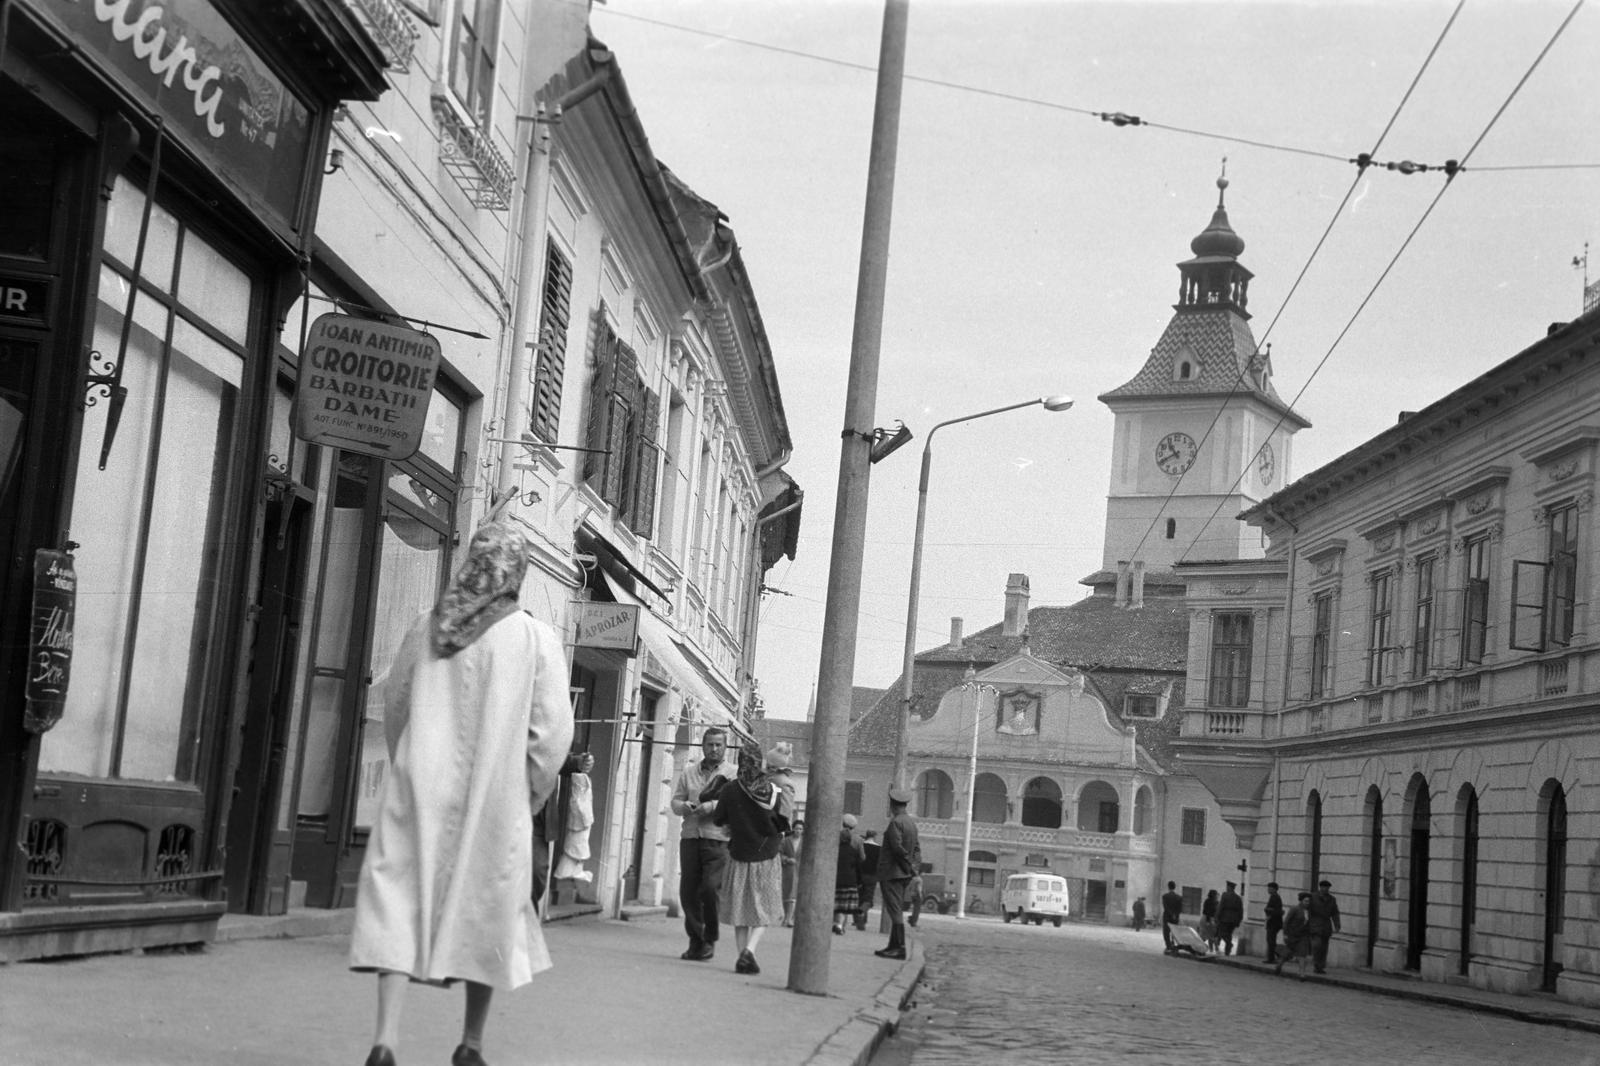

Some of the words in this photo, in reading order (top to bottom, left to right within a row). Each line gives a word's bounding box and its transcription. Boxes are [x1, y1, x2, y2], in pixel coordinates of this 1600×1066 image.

[0, 286, 28, 311] R
[320, 322, 363, 345] IOAN
[365, 332, 435, 361] ANTIMIR
[311, 345, 432, 391] CROITORIE
[324, 396, 401, 424] DAME
[584, 610, 630, 640] APROZAR
